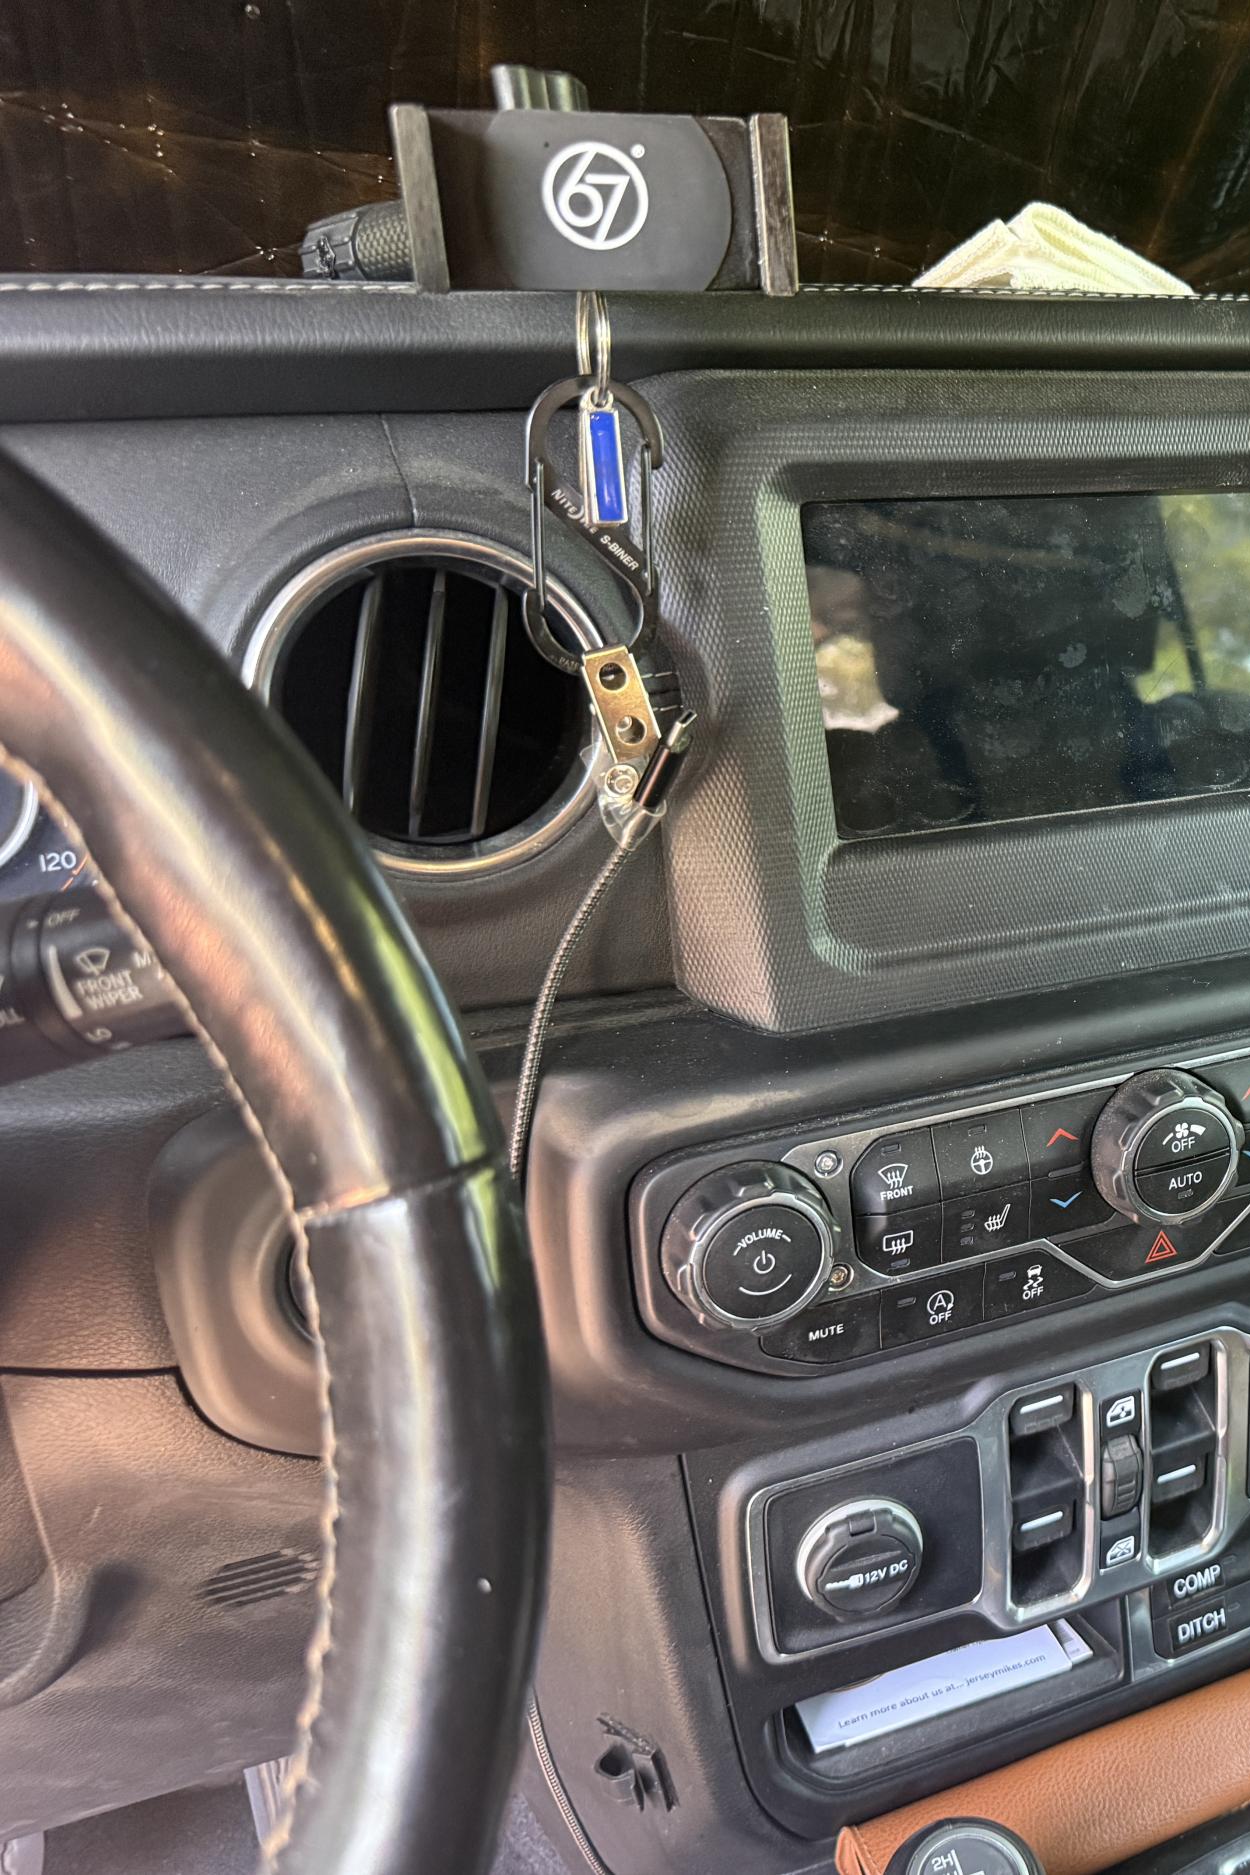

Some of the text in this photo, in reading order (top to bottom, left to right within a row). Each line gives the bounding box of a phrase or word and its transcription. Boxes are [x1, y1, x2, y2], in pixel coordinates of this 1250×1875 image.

[550, 143, 642, 246] 67
[550, 489, 578, 514] NITE
[600, 535, 640, 571] S-BINER
[39, 851, 77, 872] 120
[77, 970, 132, 996] FRONT
[86, 985, 144, 1010] WIPER
[1171, 1136, 1196, 1153] OFF
[1168, 1171, 1203, 1191] AUTO
[880, 1186, 914, 1201] FRONT
[737, 1228, 783, 1248] VOLUME
[1022, 1286, 1044, 1300] OFF
[929, 1310, 952, 1325] OFF
[808, 1323, 845, 1342] MUTE
[864, 1559, 909, 1585] 12V DC
[1173, 1564, 1221, 1599] COMP
[1177, 1607, 1226, 1644] DITCH
[838, 1653, 1047, 1729] Learn more about us at... jerseymikes.com
[931, 1853, 955, 1872] 2H
